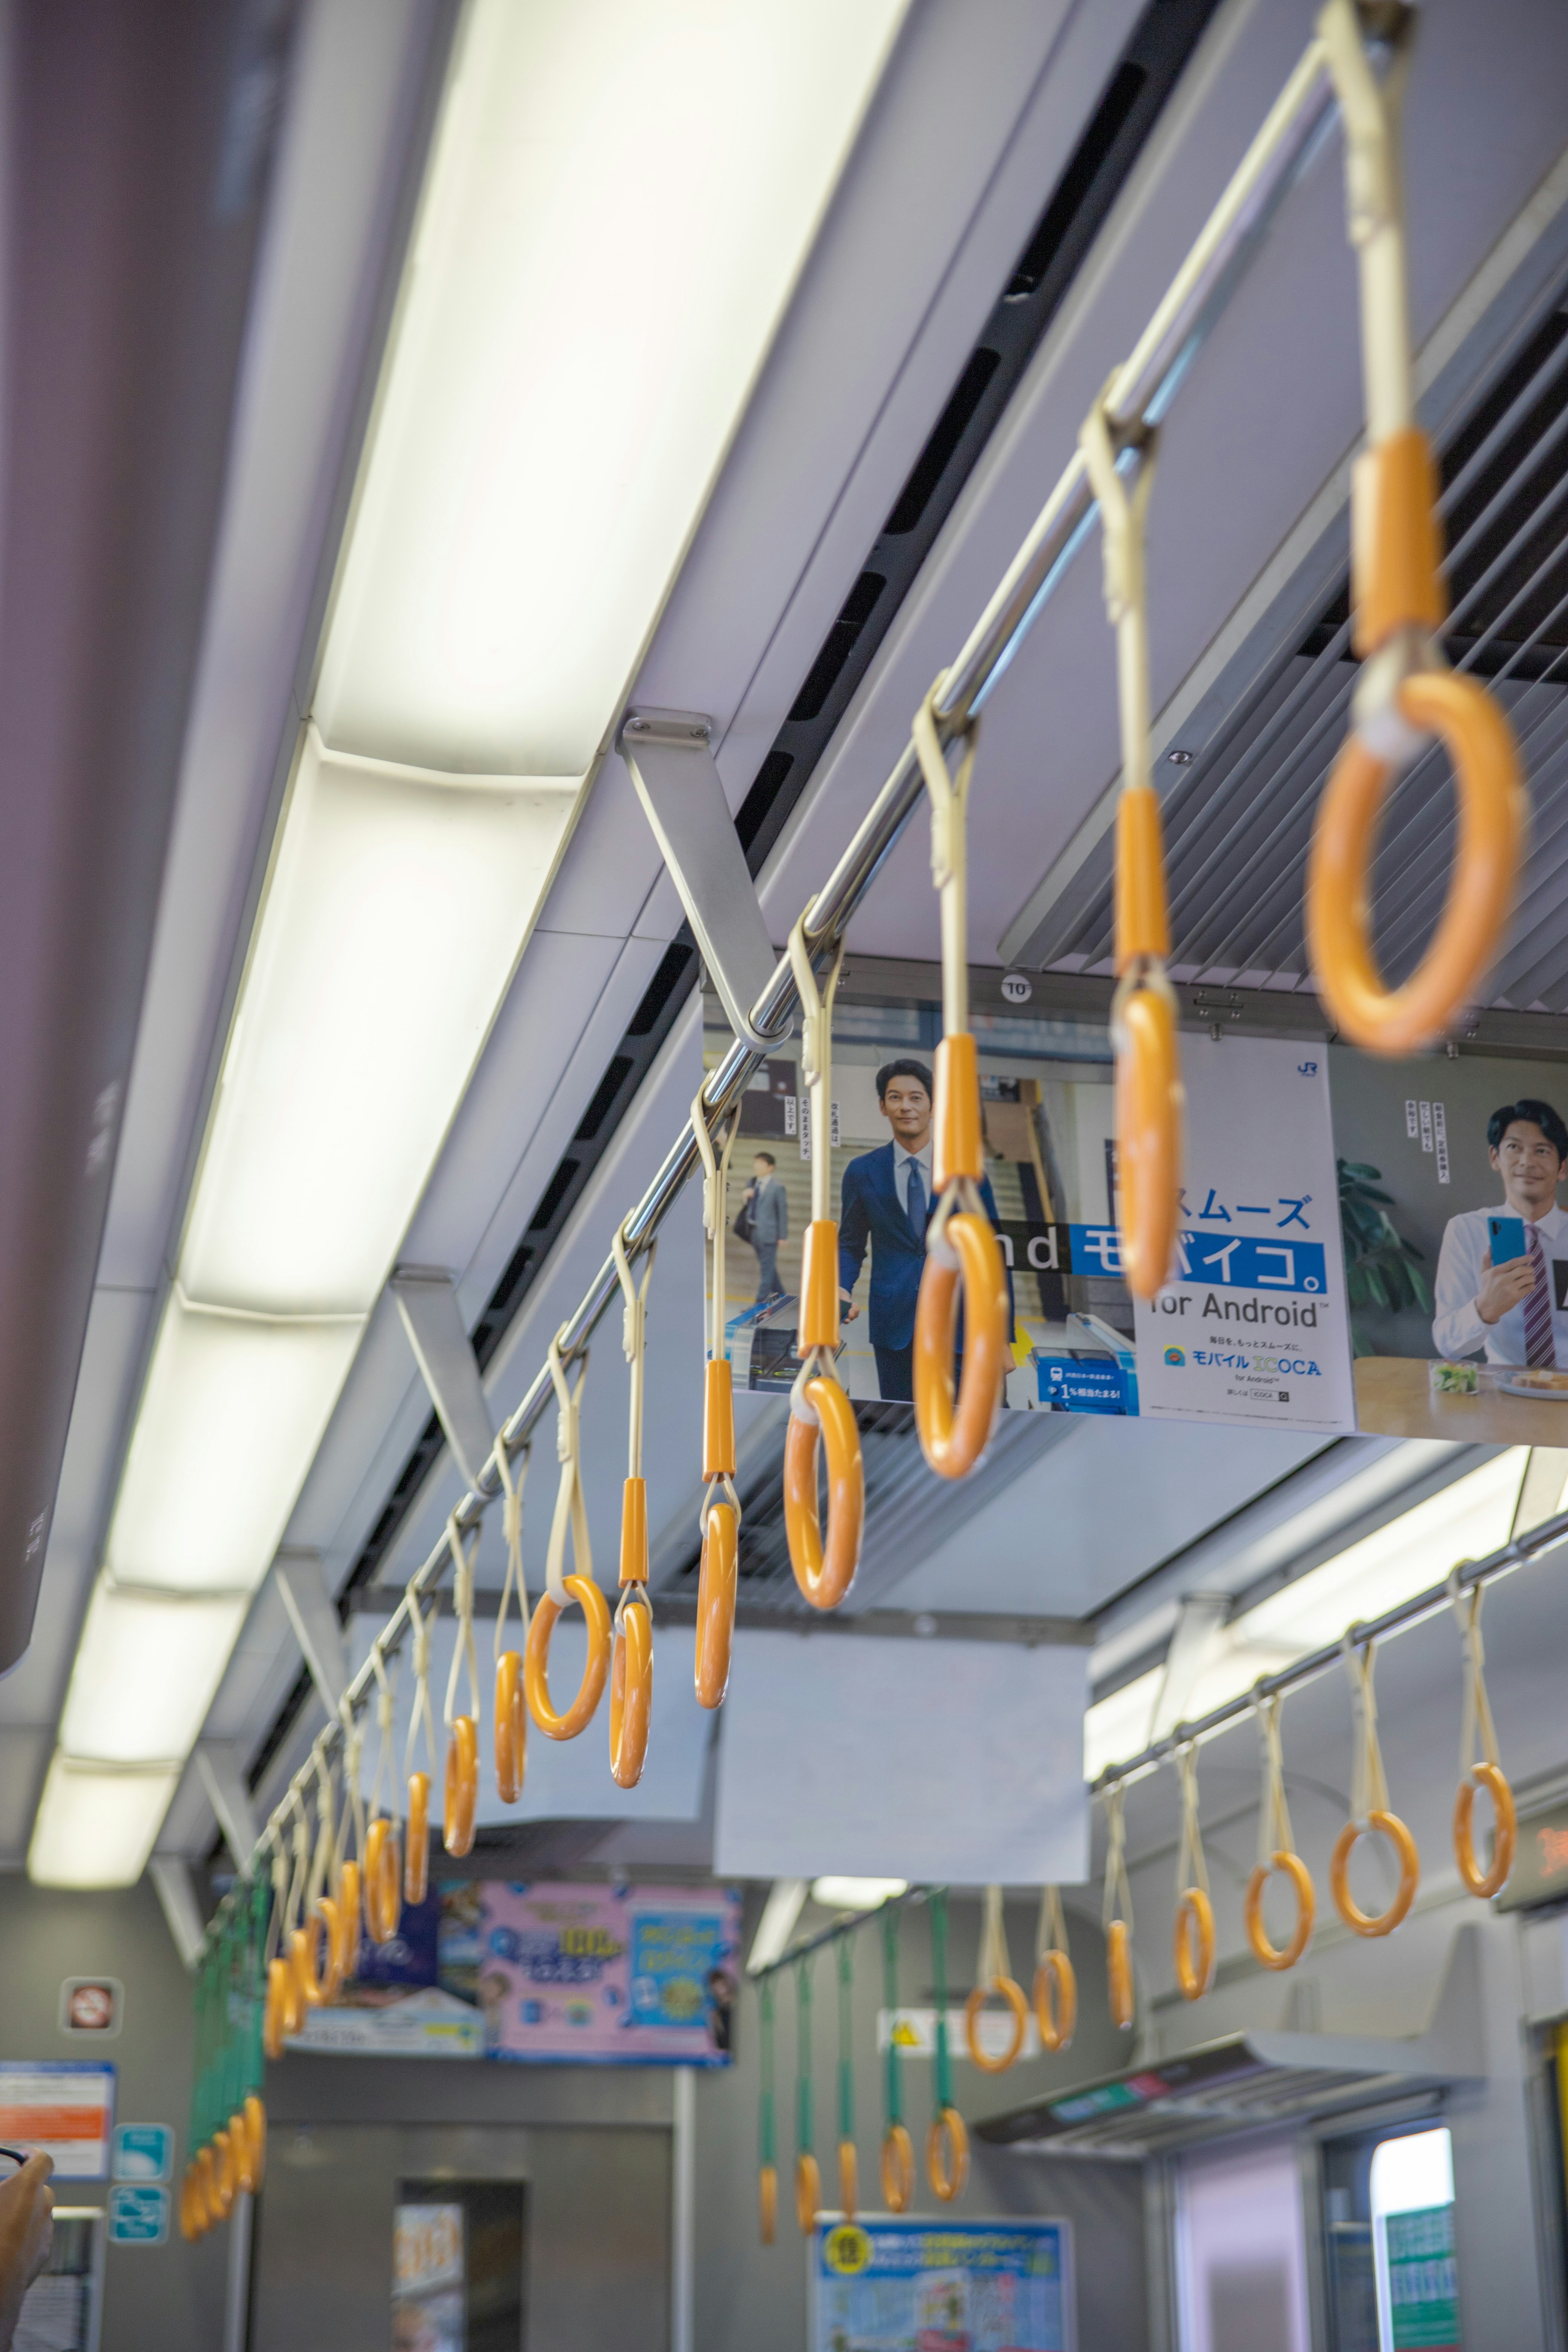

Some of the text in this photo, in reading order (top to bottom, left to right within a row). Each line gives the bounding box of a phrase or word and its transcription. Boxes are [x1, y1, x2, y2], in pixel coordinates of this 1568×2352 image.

[1008, 982, 1026, 995] 10
[1297, 1062, 1317, 1073] JR
[993, 1226, 1059, 1269] nd
[1193, 1351, 1322, 1376] モバイル ICOCA
